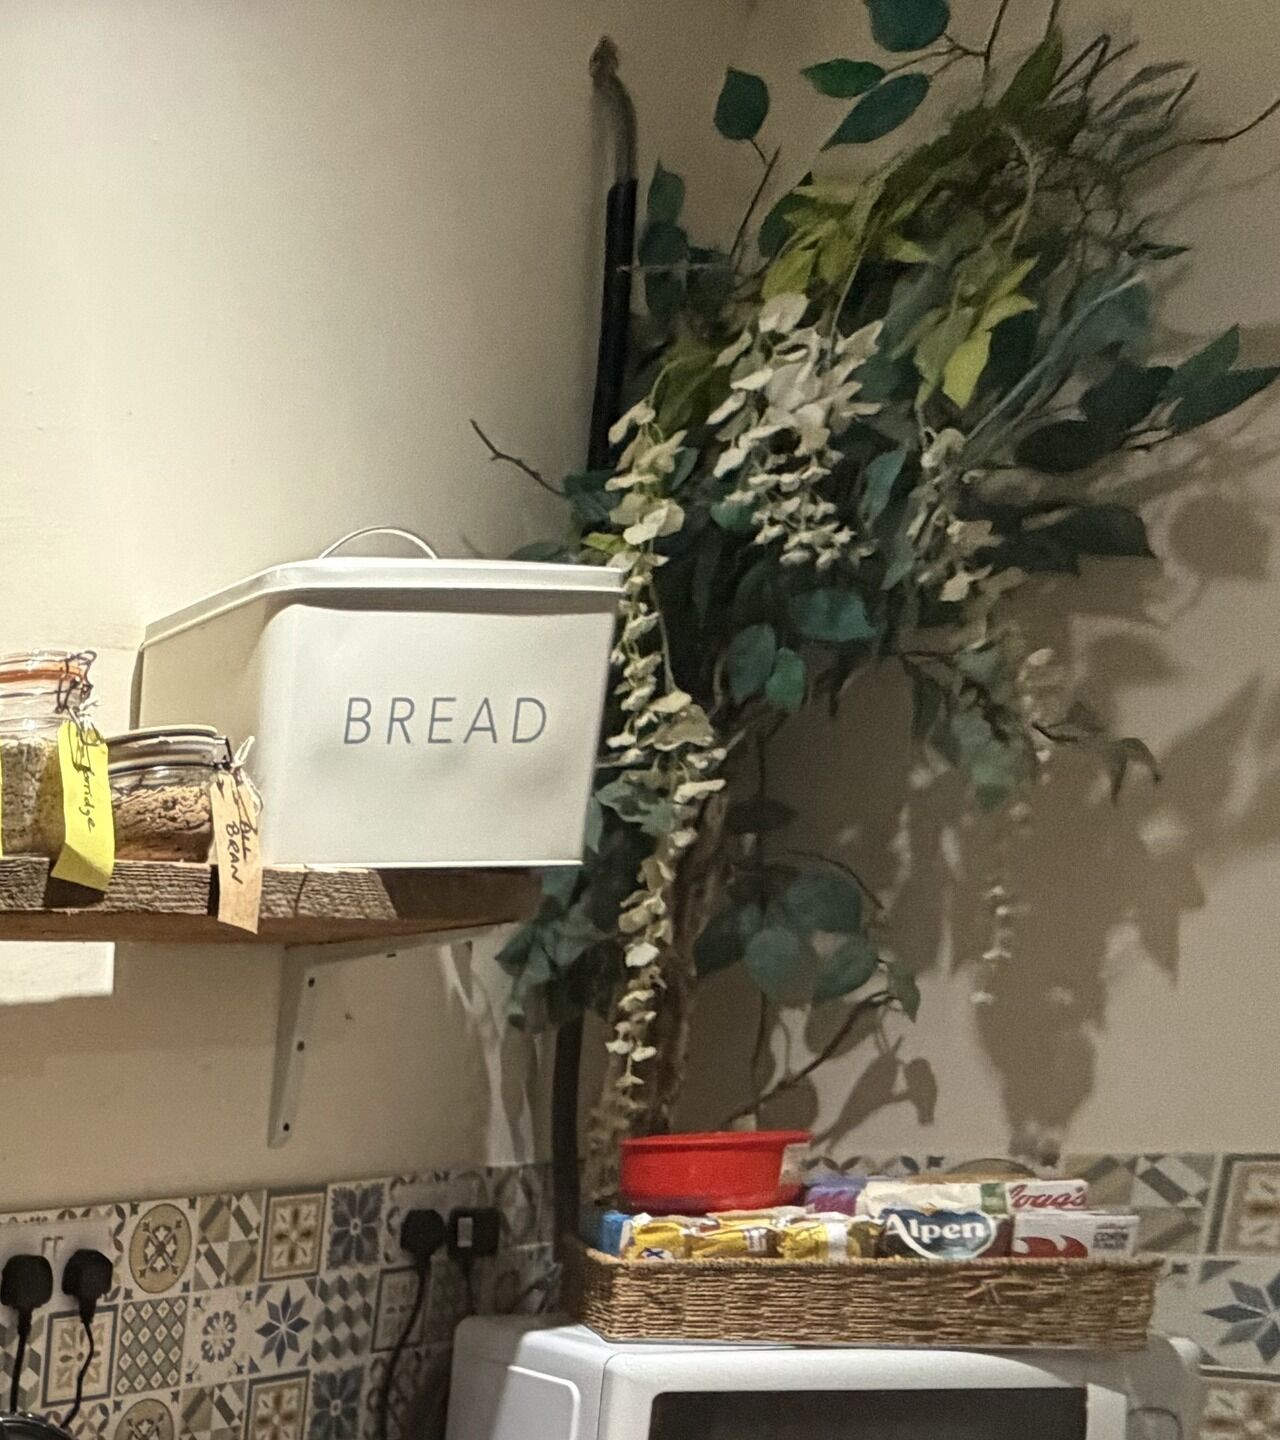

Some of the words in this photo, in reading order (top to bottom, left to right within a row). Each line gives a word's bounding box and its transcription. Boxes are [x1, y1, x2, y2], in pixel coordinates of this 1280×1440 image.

[343, 697, 548, 745] BREAD
[225, 820, 244, 885] BRAN
[885, 1214, 986, 1243] Alpen
